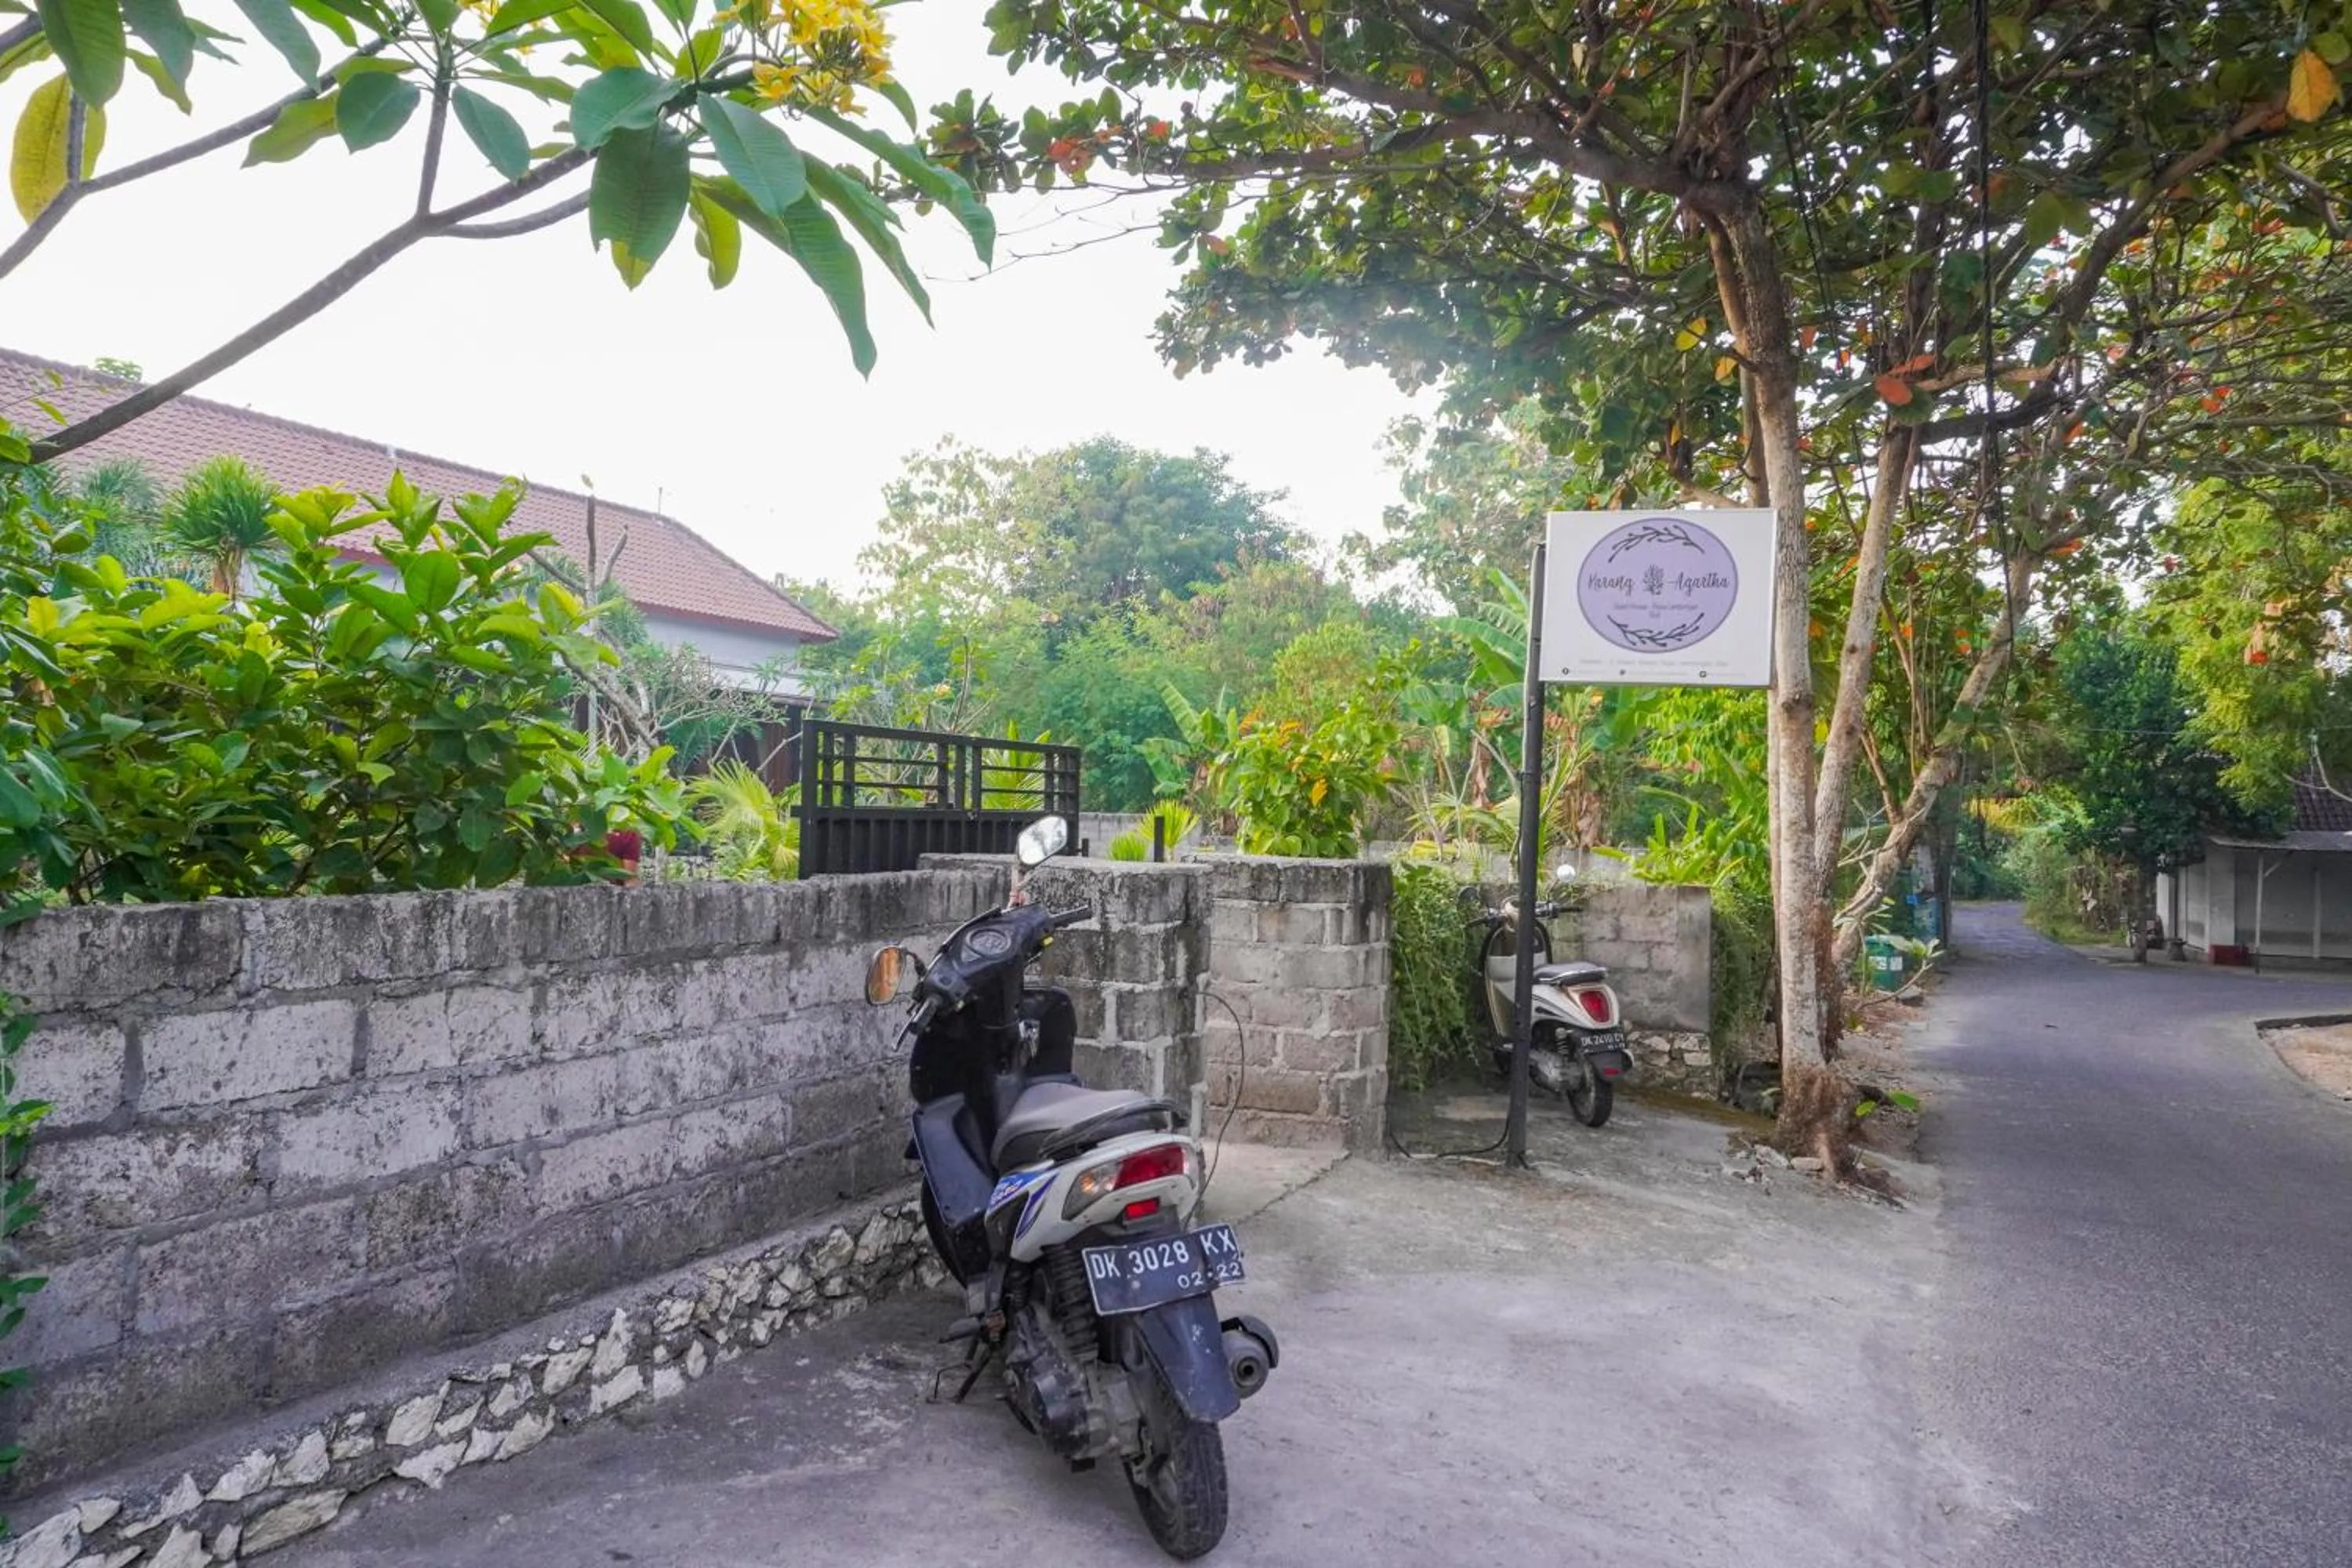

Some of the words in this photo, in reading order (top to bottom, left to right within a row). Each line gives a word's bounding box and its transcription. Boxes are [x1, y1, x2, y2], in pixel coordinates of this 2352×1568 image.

[1588, 572, 1634, 596] Karang
[1667, 572, 1730, 596] Agartha
[1089, 1253, 1121, 1279] DK
[1129, 1240, 1189, 1275] 3028
[1200, 1228, 1236, 1256] KX
